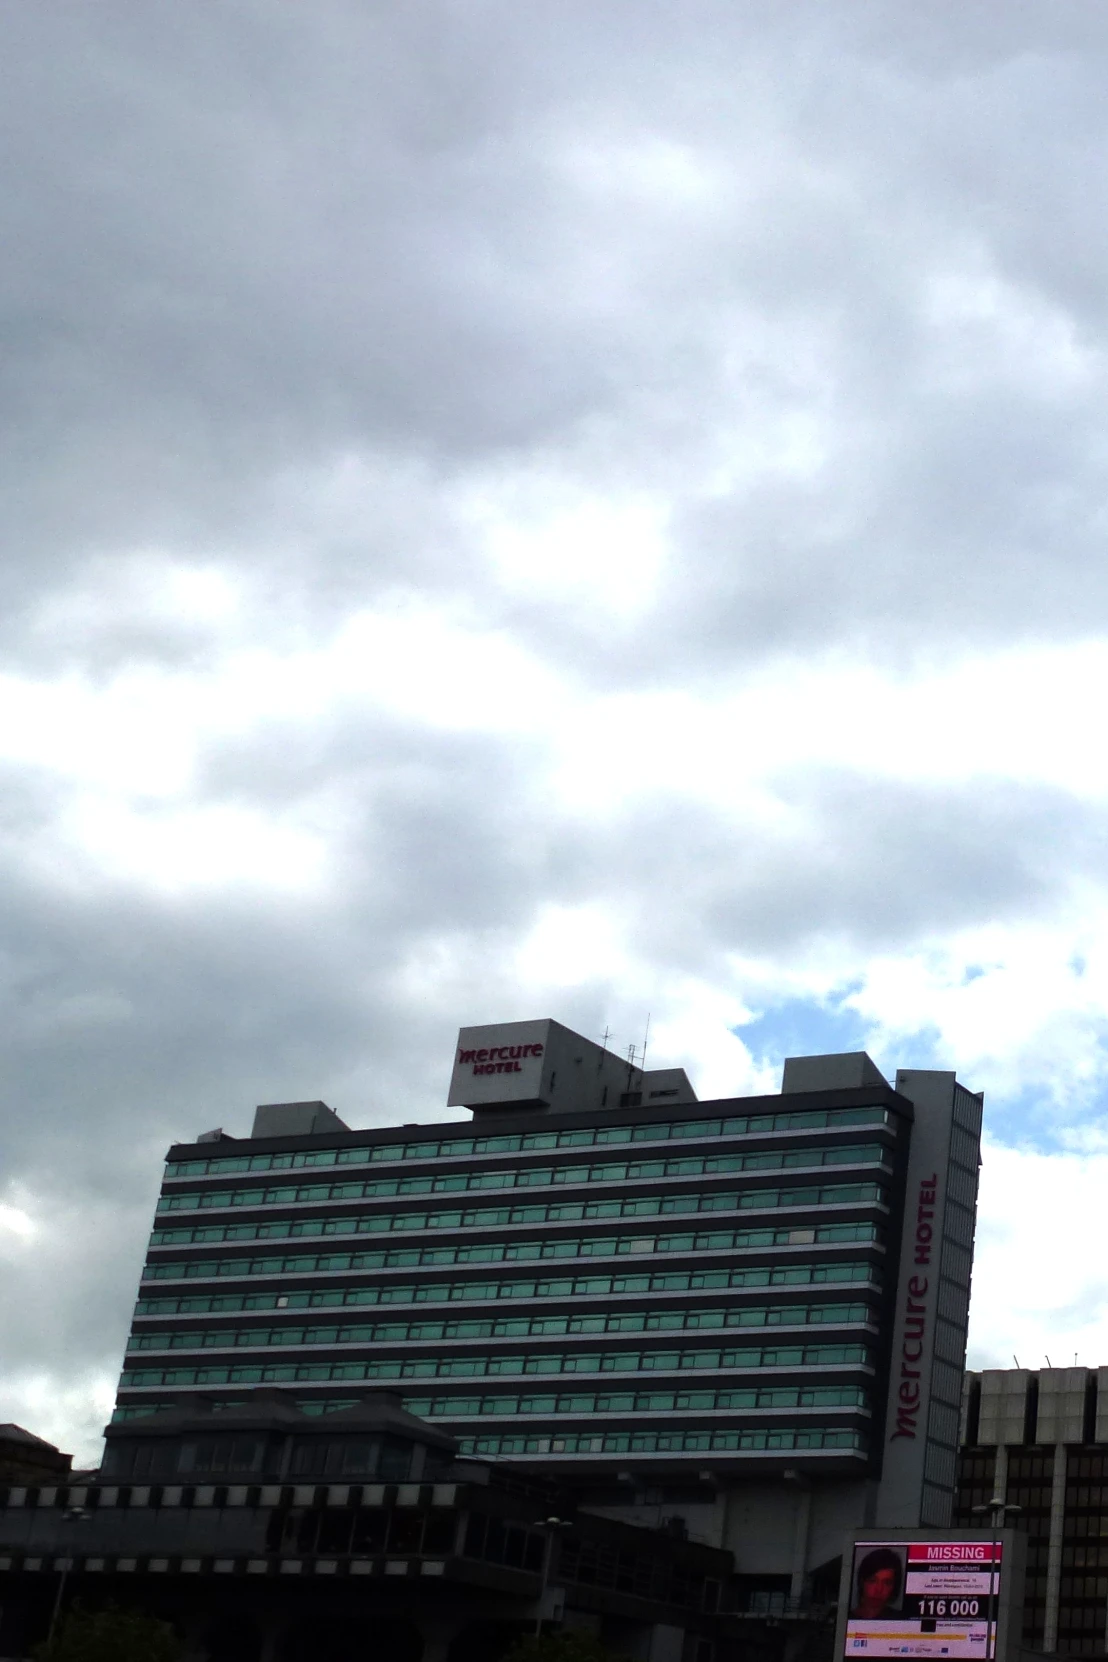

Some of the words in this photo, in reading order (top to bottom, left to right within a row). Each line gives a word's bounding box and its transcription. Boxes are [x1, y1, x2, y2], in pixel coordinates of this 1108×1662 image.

[473, 1061, 523, 1075] HOTEL
[914, 1173, 937, 1265] HOTEL
[927, 1547, 984, 1559] MISSING
[918, 1600, 946, 1615] 116
[950, 1600, 979, 1615] 000
